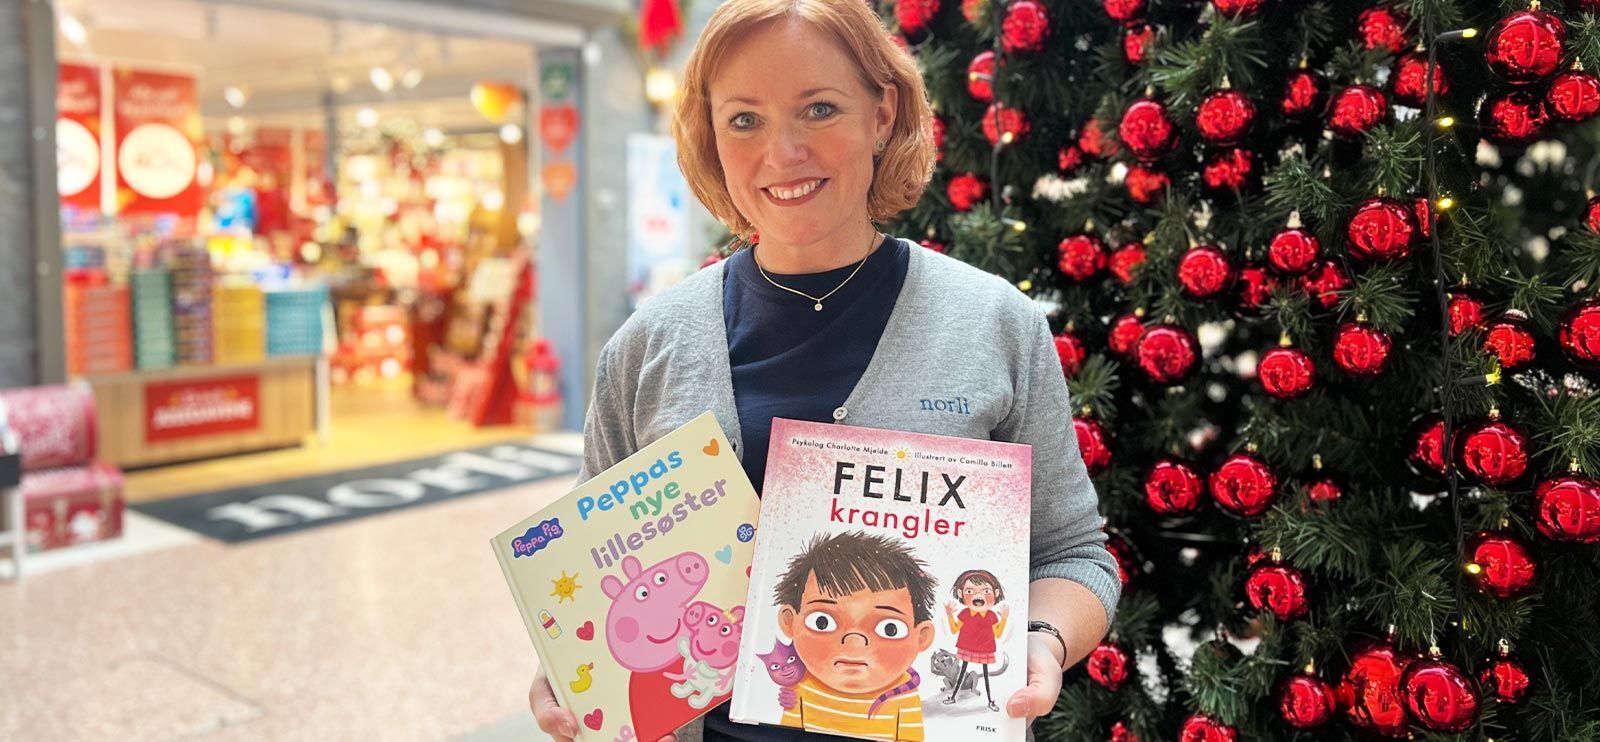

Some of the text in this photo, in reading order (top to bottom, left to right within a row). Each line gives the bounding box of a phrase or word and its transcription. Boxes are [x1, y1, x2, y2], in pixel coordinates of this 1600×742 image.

[919, 396, 971, 415] norli
[791, 437, 824, 449] Psykolog
[826, 441, 861, 453] Charlotte
[914, 452, 946, 462] Illustrert
[959, 456, 989, 467] Camilla
[990, 460, 1013, 469] Billett
[208, 444, 573, 532] norli
[576, 450, 684, 521] Peppas
[629, 481, 681, 520] nye
[833, 461, 967, 509] FELIX
[590, 478, 727, 569] lillesøster
[830, 497, 966, 539] krangler
[513, 522, 560, 554] Peppa Pig
[975, 725, 997, 734] FRISK
